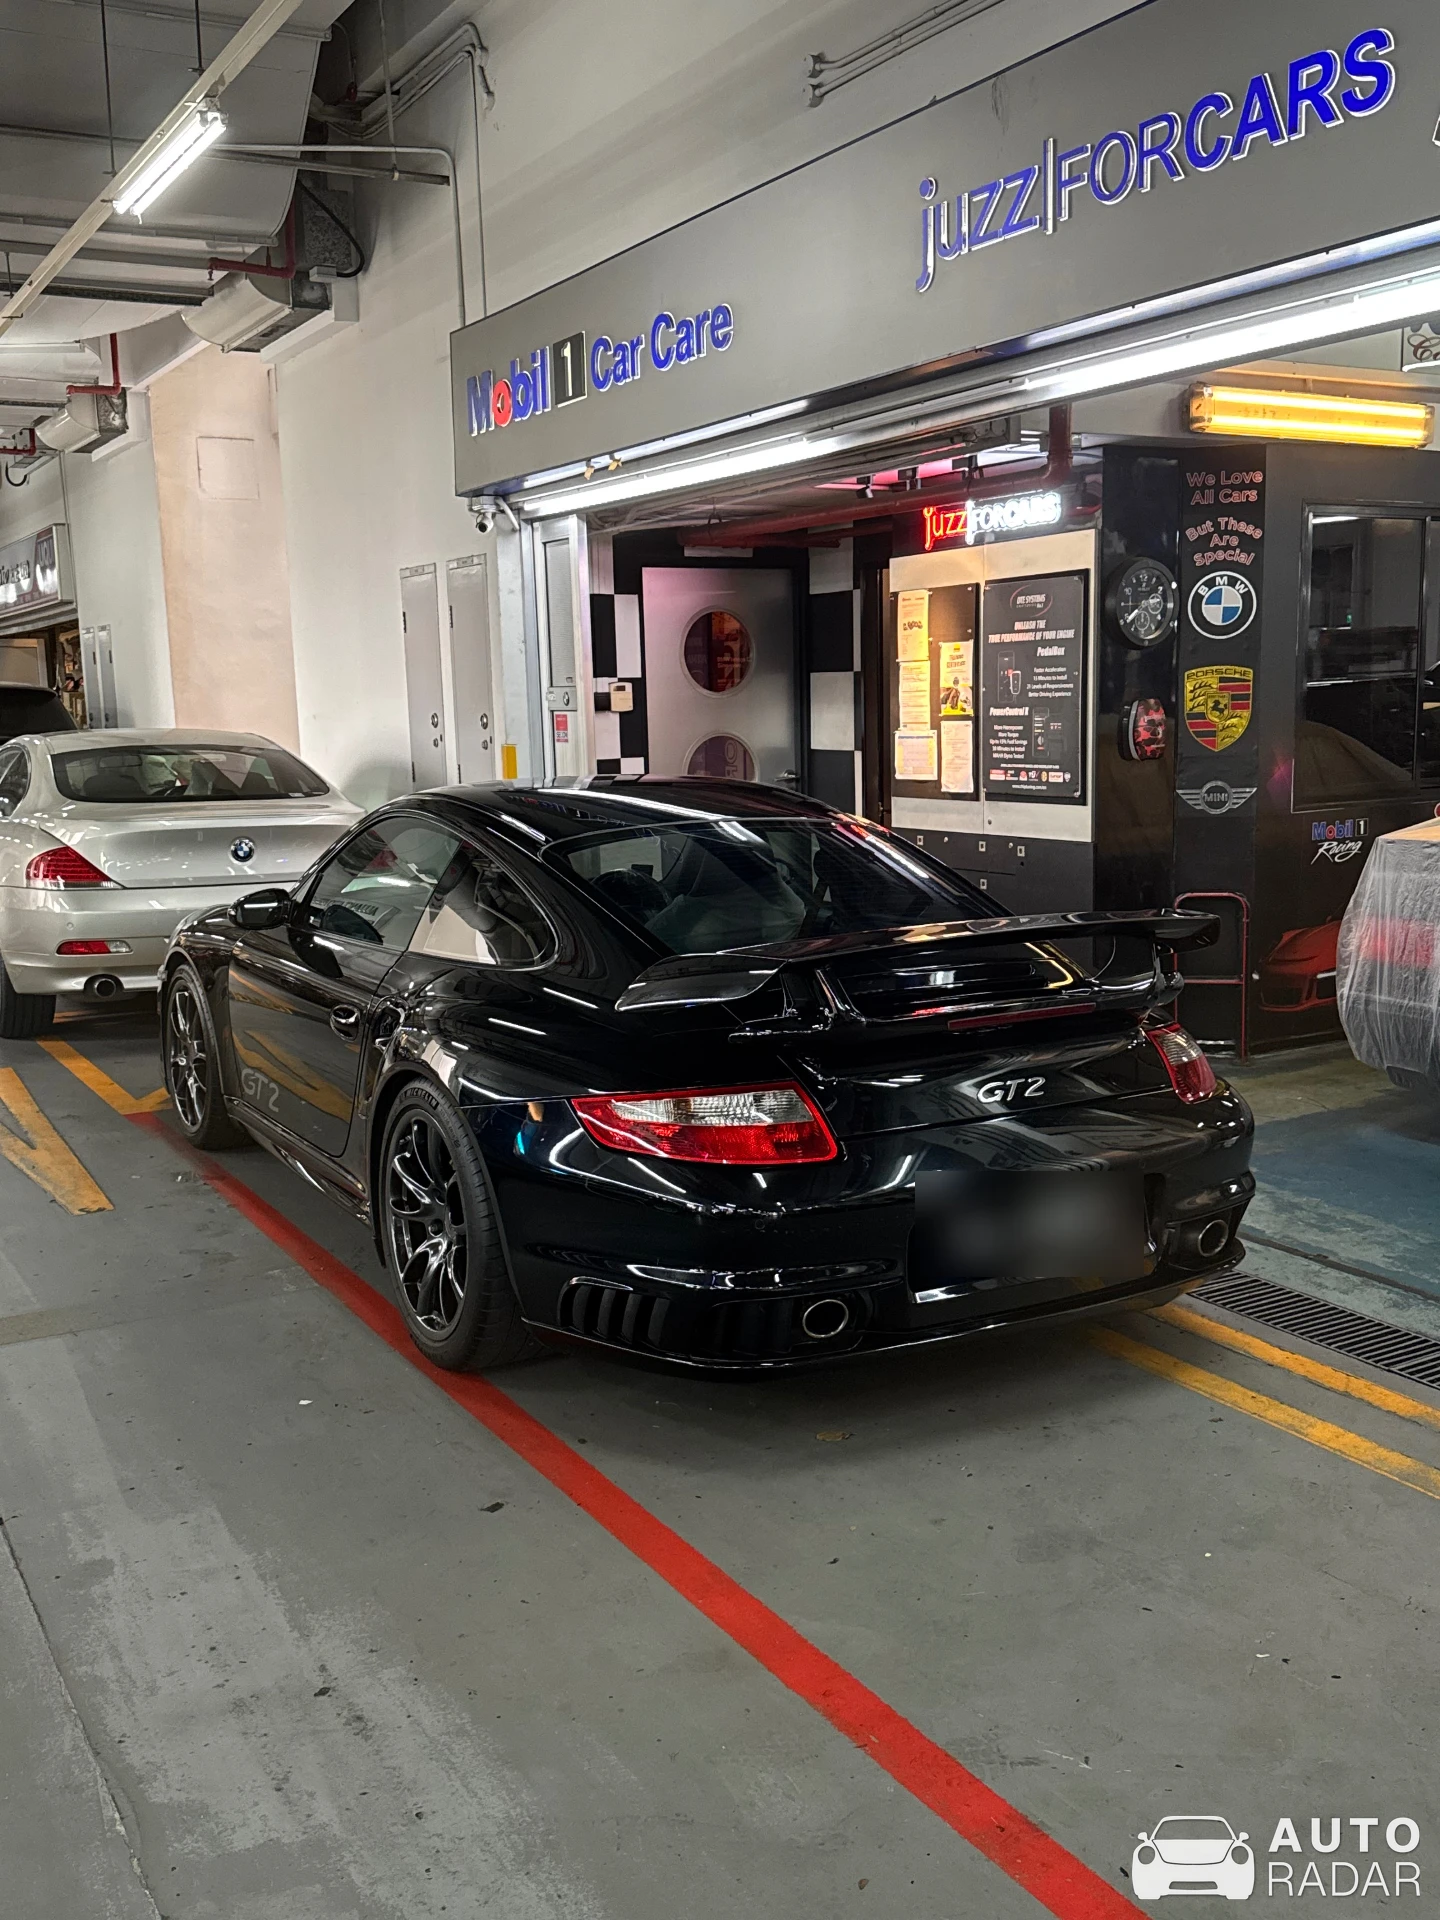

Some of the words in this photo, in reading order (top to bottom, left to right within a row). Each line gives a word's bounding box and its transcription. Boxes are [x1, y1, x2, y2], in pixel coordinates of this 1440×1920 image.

[467, 345, 551, 436] Mobil
[591, 336, 645, 391] Car
[650, 303, 733, 371] Care
[1186, 472, 1216, 487] We
[1220, 471, 1263, 485] Love
[1191, 489, 1214, 505] All
[1219, 488, 1258, 503] Cars
[1185, 520, 1214, 541] But
[1218, 516, 1263, 539] These
[1209, 533, 1239, 547] Are
[1193, 548, 1255, 566] Special
[1197, 576, 1249, 596] BMW
[1000, 631, 1036, 643] PERFORMANCE
[1186, 668, 1252, 680] PORSCHE
[1204, 793, 1229, 802] MINI
[1312, 819, 1354, 840] Mobil
[1311, 840, 1363, 865] Racing
